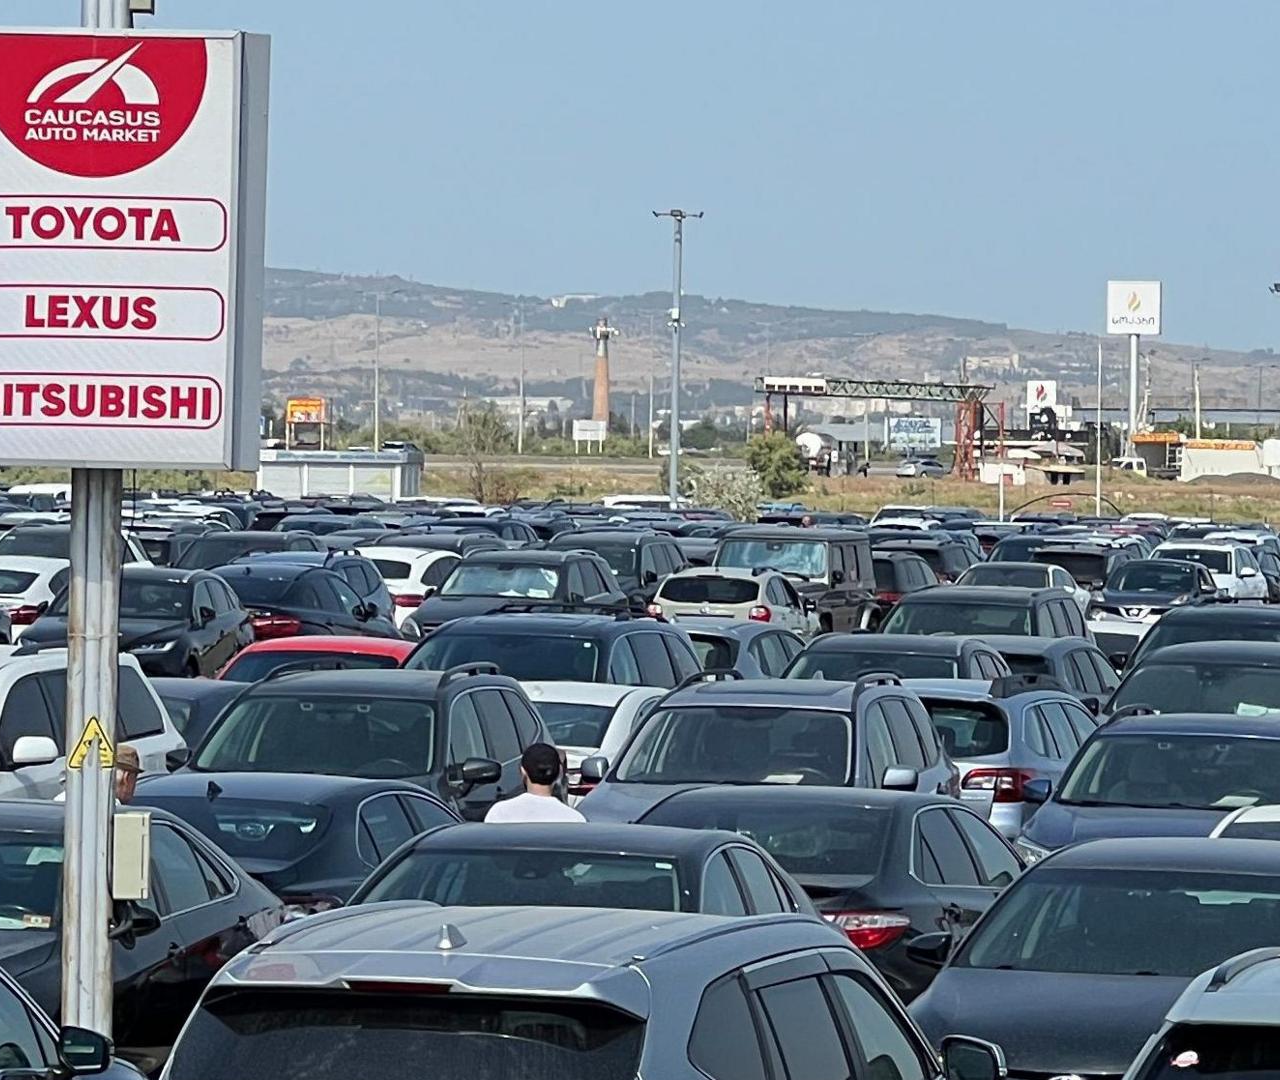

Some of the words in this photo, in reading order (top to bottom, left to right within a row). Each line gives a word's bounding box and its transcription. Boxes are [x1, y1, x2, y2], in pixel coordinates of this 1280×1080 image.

[23, 108, 161, 127] CAUCASUS
[24, 127, 77, 141] AUTO
[82, 128, 160, 143] MARKET
[5, 206, 181, 242] TOYOTA
[24, 294, 157, 330] LEXUS
